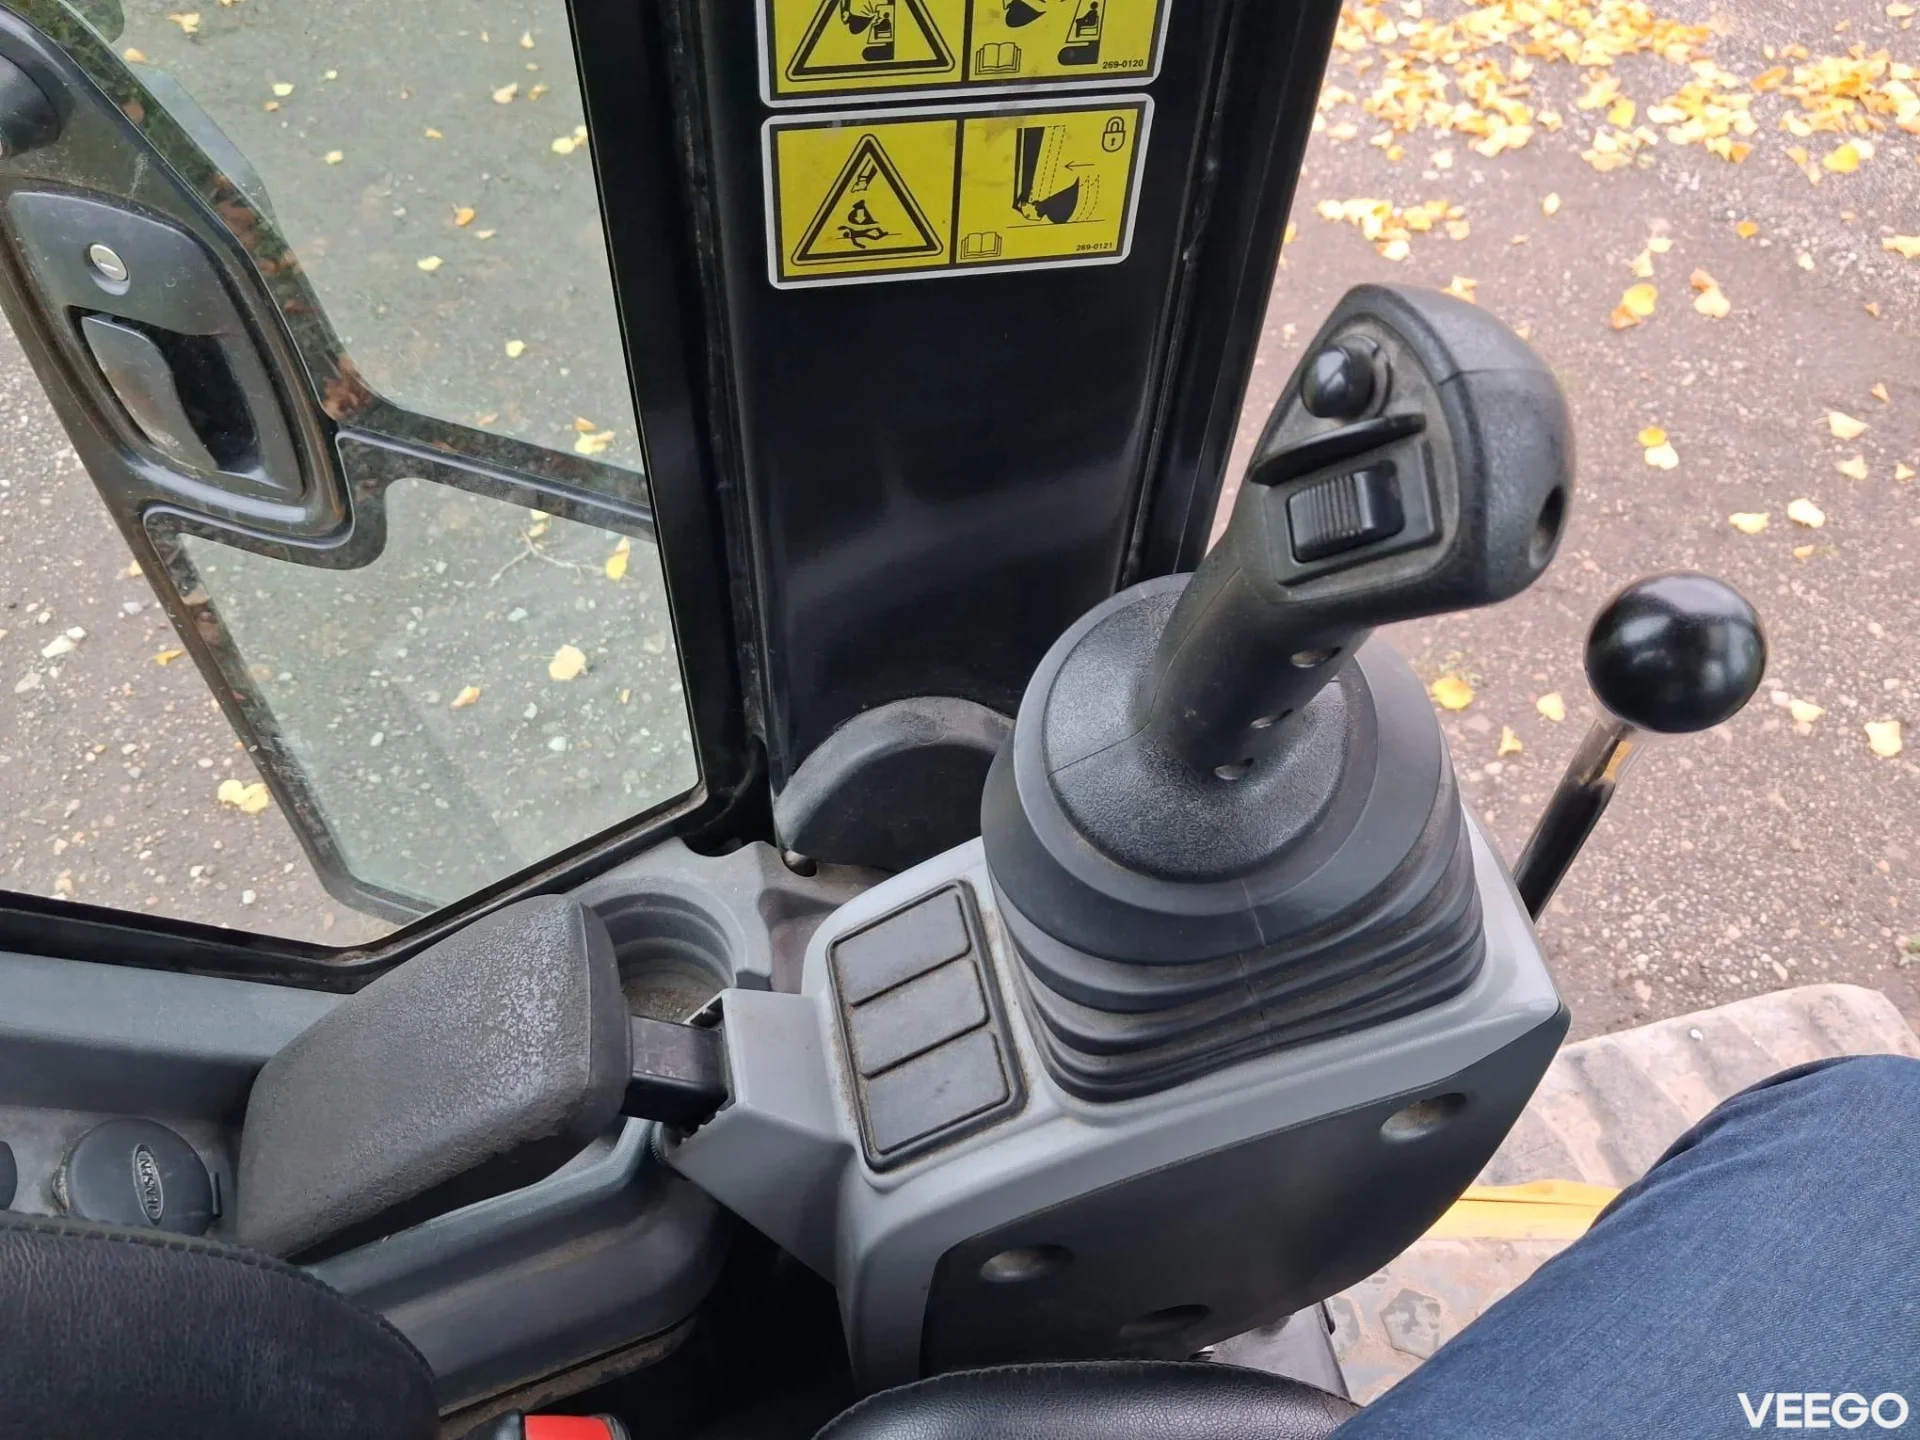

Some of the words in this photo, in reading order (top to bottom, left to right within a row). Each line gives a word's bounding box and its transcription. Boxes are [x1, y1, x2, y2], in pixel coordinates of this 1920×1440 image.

[1102, 58, 1144, 69] 269-0120
[1076, 241, 1113, 251] 269-0121
[139, 1158, 159, 1212] JENSEN
